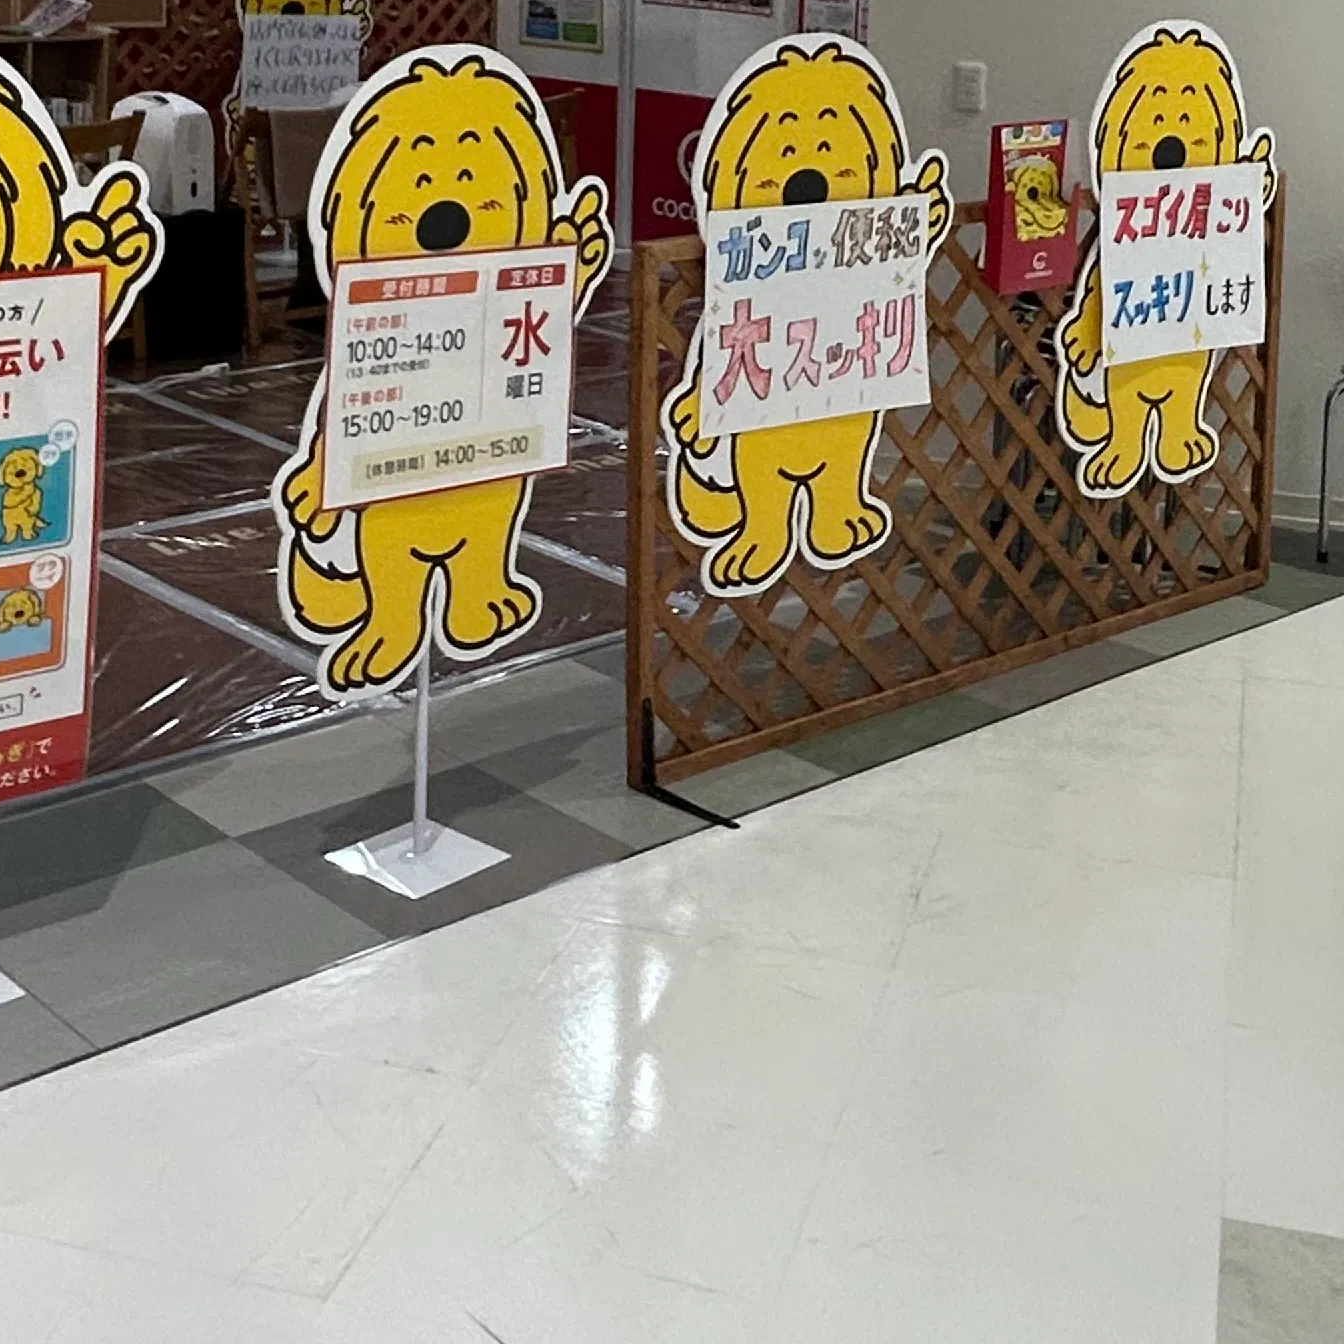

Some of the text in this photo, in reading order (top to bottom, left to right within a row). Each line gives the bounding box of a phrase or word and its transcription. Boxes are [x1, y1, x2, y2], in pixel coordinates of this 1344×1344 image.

[1112, 182, 1250, 244] スゴイ肩こり
[381, 276, 448, 299] 受付時間
[510, 266, 554, 286] 定休日
[1111, 270, 1255, 329] スッキリします
[500, 301, 551, 367] 水
[713, 293, 916, 406] 大スッキリ
[505, 372, 543, 399] 曜日
